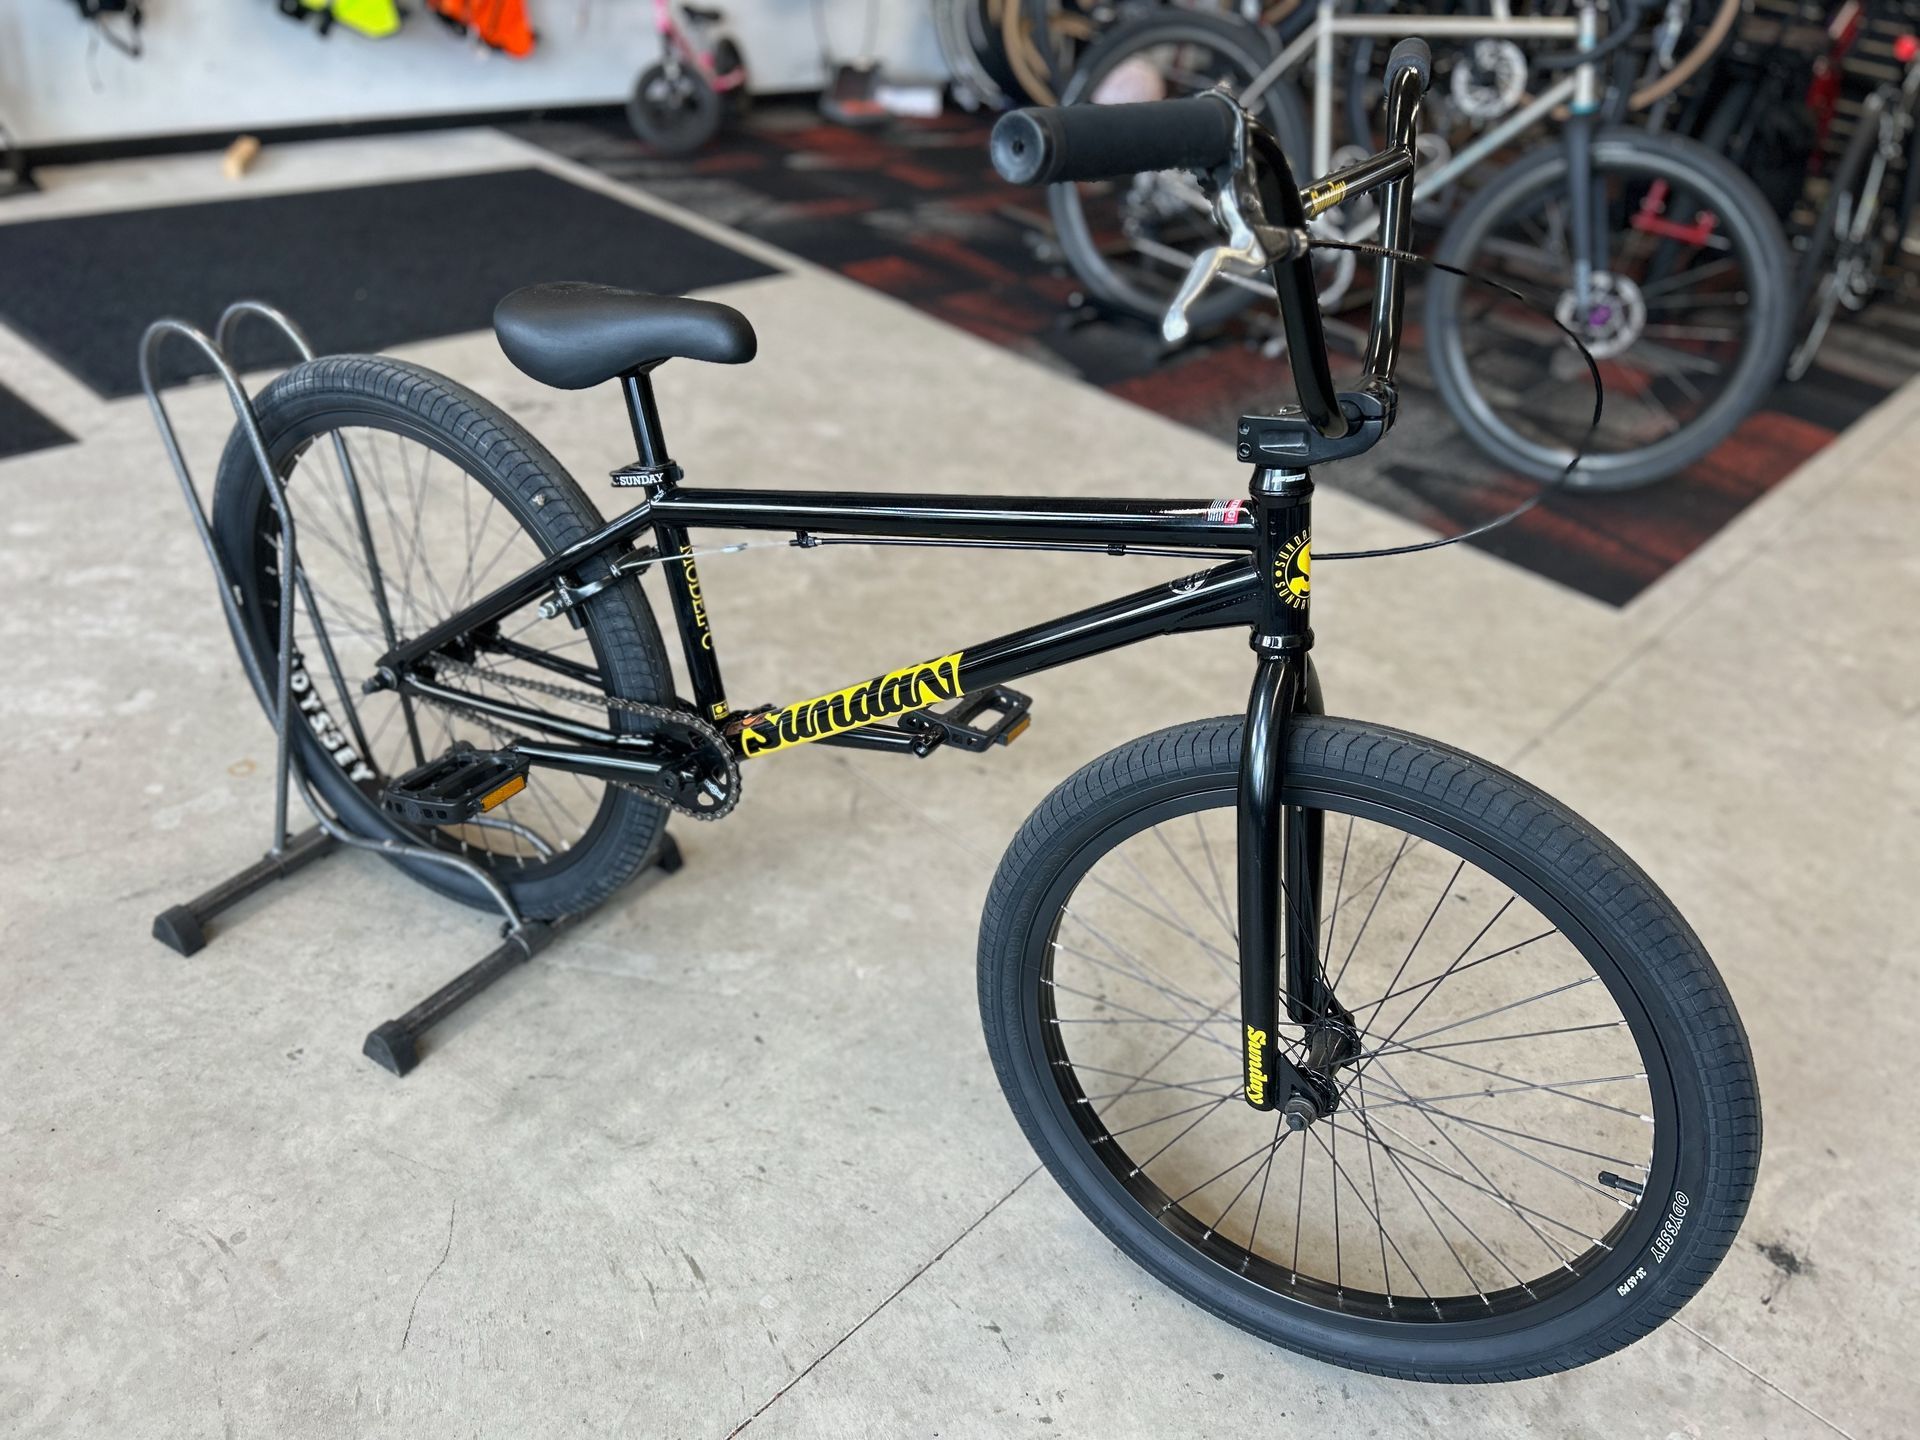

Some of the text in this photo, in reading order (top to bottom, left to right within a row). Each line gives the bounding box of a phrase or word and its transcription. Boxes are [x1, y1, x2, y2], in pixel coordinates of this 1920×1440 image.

[619, 472, 664, 486] SUNDAY
[1274, 526, 1311, 568] SUNDA
[1274, 581, 1309, 610] SUNDA
[1246, 1024, 1268, 1105] Sunday
[1650, 1190, 1690, 1264] ODYSSEY
